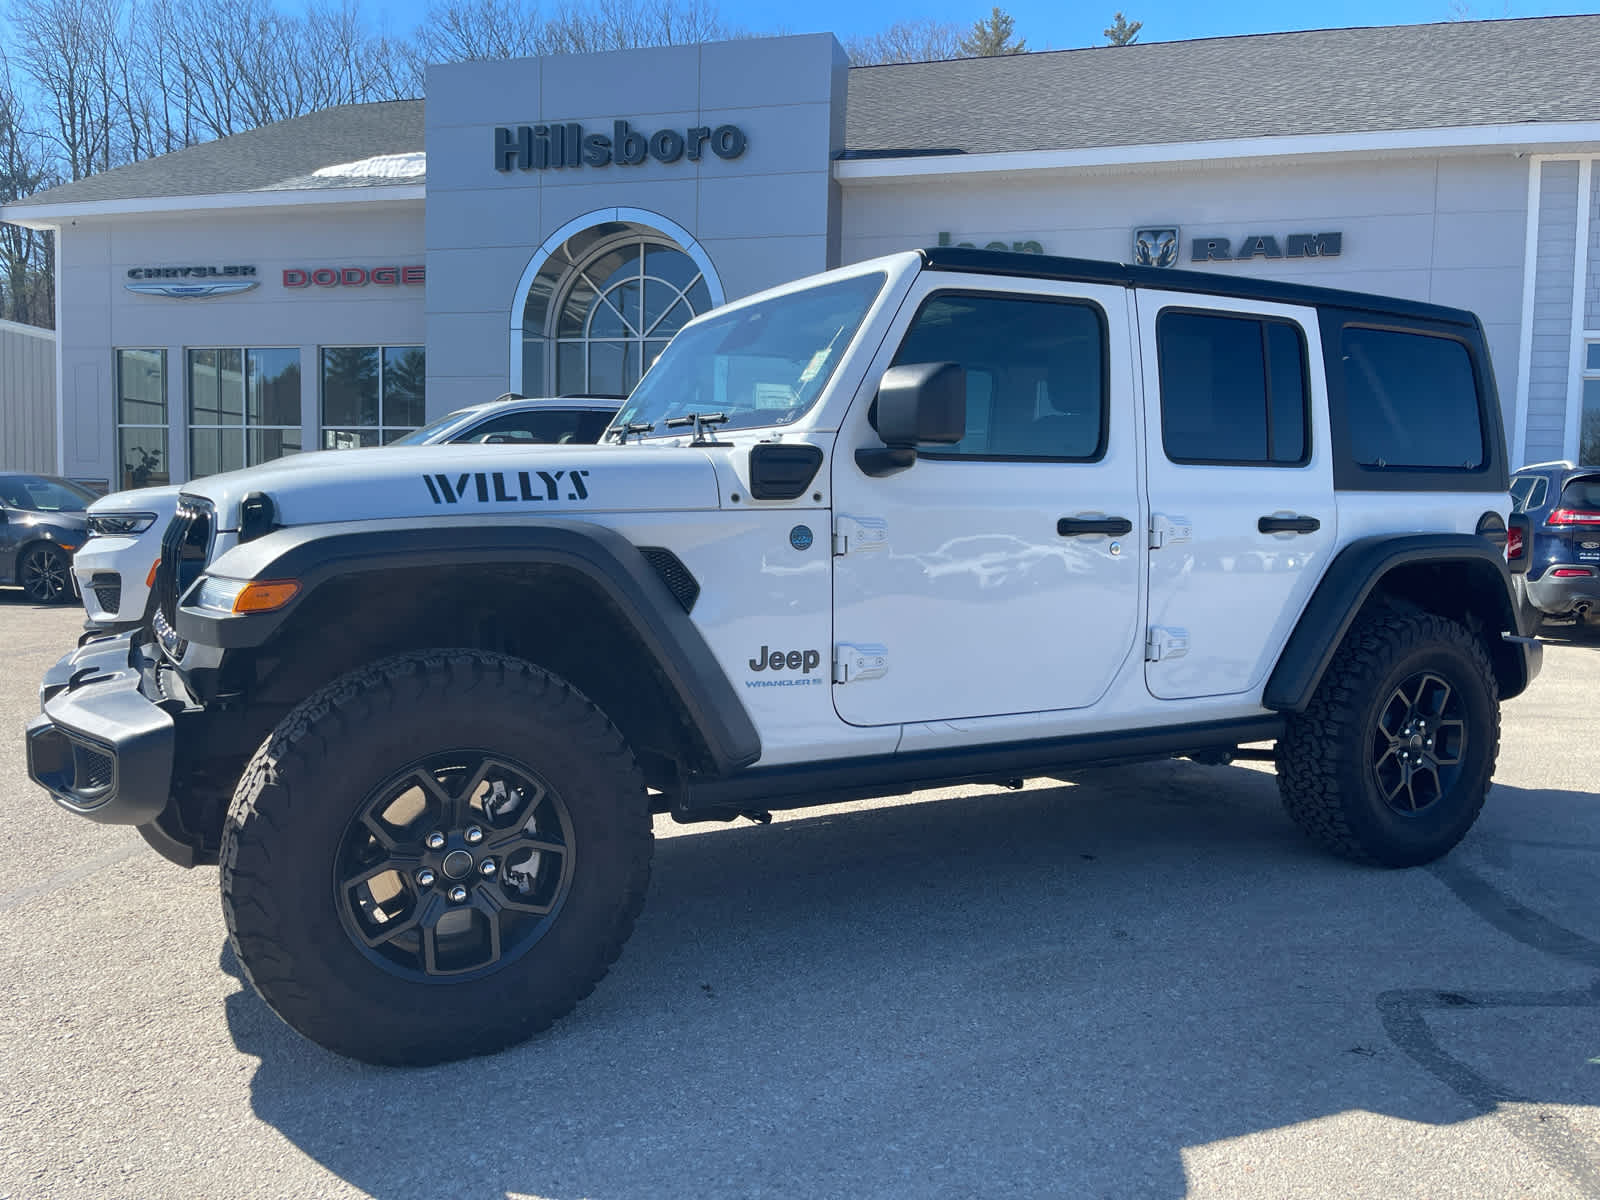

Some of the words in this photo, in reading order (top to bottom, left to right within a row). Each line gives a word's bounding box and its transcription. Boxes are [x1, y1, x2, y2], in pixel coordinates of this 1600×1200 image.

[494, 120, 747, 172] Hillsboro
[1191, 232, 1343, 261] RAM
[127, 265, 257, 280] CHRYSLER
[282, 266, 425, 288] DODGE
[422, 470, 590, 504] WILLYS
[749, 645, 820, 674] Jeep
[745, 679, 810, 688] WRANGLER
